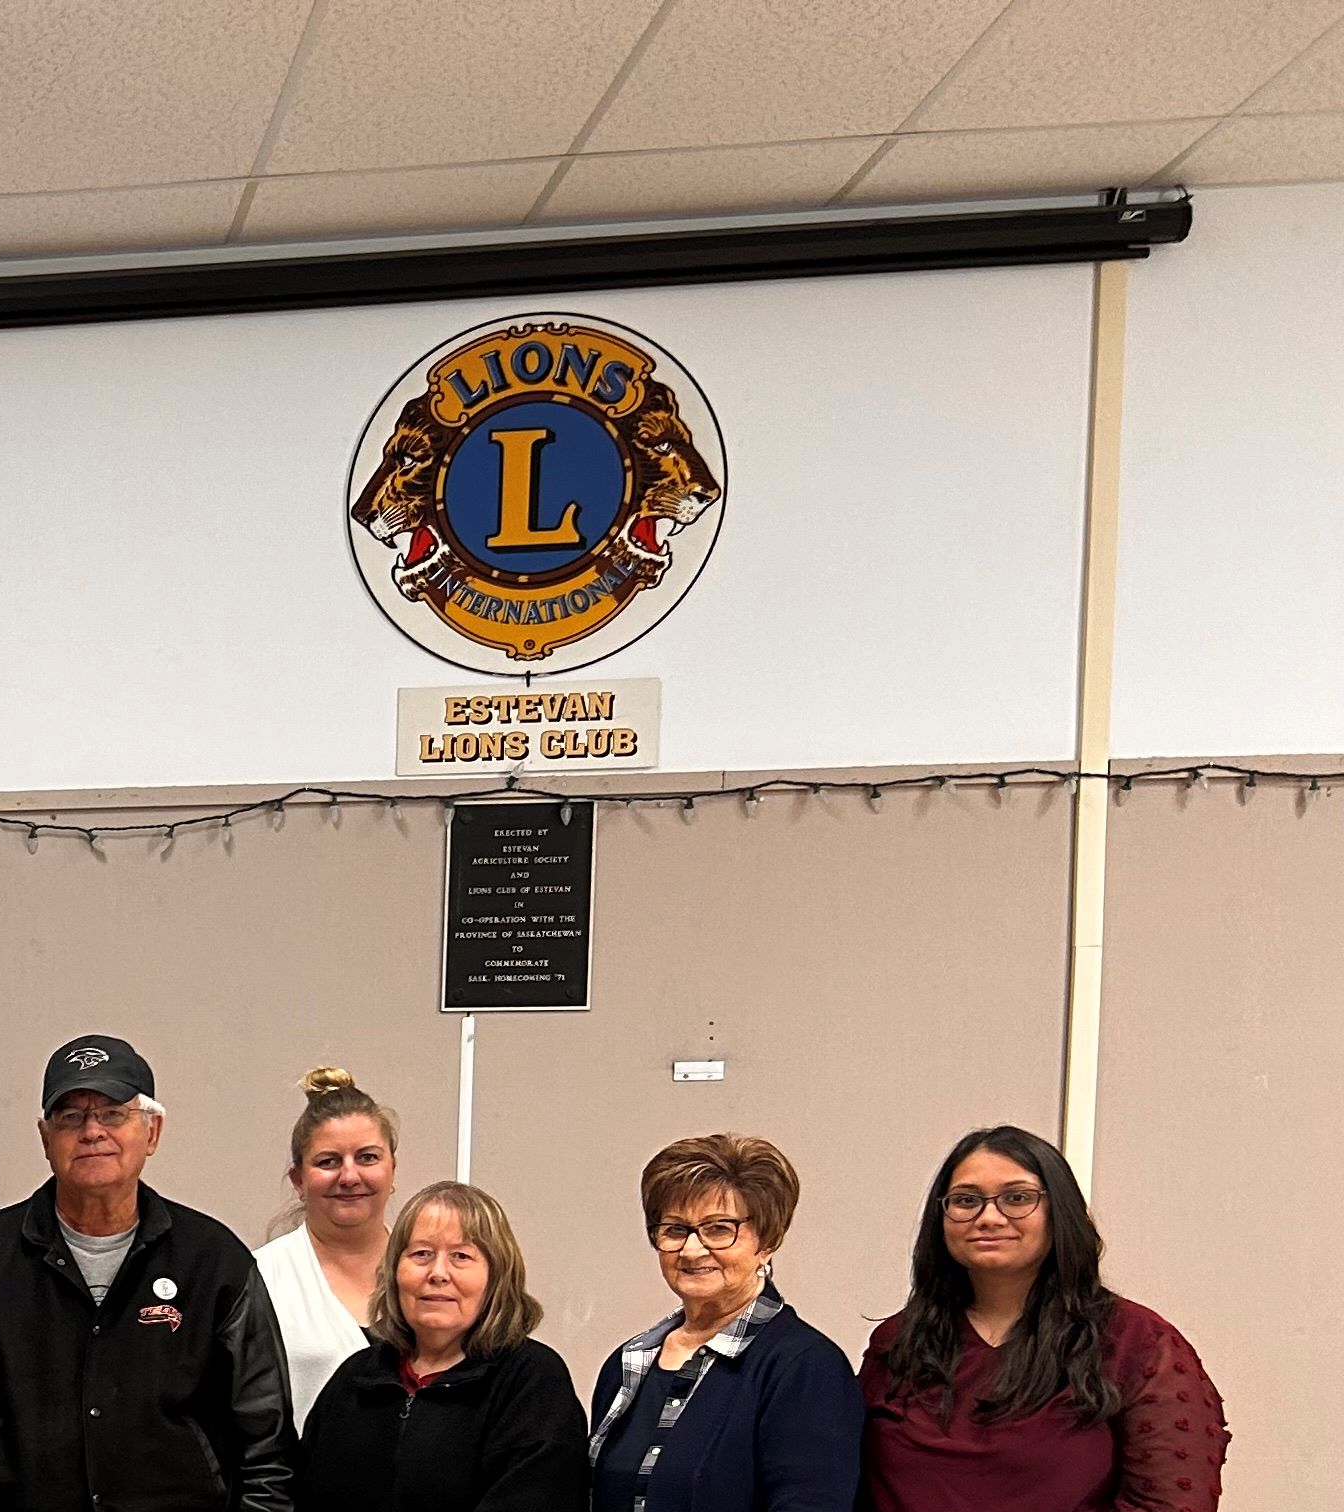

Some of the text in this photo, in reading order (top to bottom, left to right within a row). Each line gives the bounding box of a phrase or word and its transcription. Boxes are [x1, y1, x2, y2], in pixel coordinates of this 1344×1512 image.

[444, 341, 634, 408] LIONS
[486, 427, 584, 552] L
[428, 560, 637, 625] INTERNATIONAL
[444, 692, 615, 725] ESTEVAN
[419, 728, 638, 763] LIONS CLUB
[502, 845, 540, 853] ESTEVAN
[534, 856, 570, 864] SOCIETY
[534, 885, 571, 893] ESTEVAN
[461, 915, 576, 924] CO-OPERATION WITH THE
[455, 931, 497, 939] PROVINCE
[517, 929, 582, 938] SASKATCHEWAN
[512, 945, 523, 953] TO
[494, 974, 551, 982] HOMECOMING
